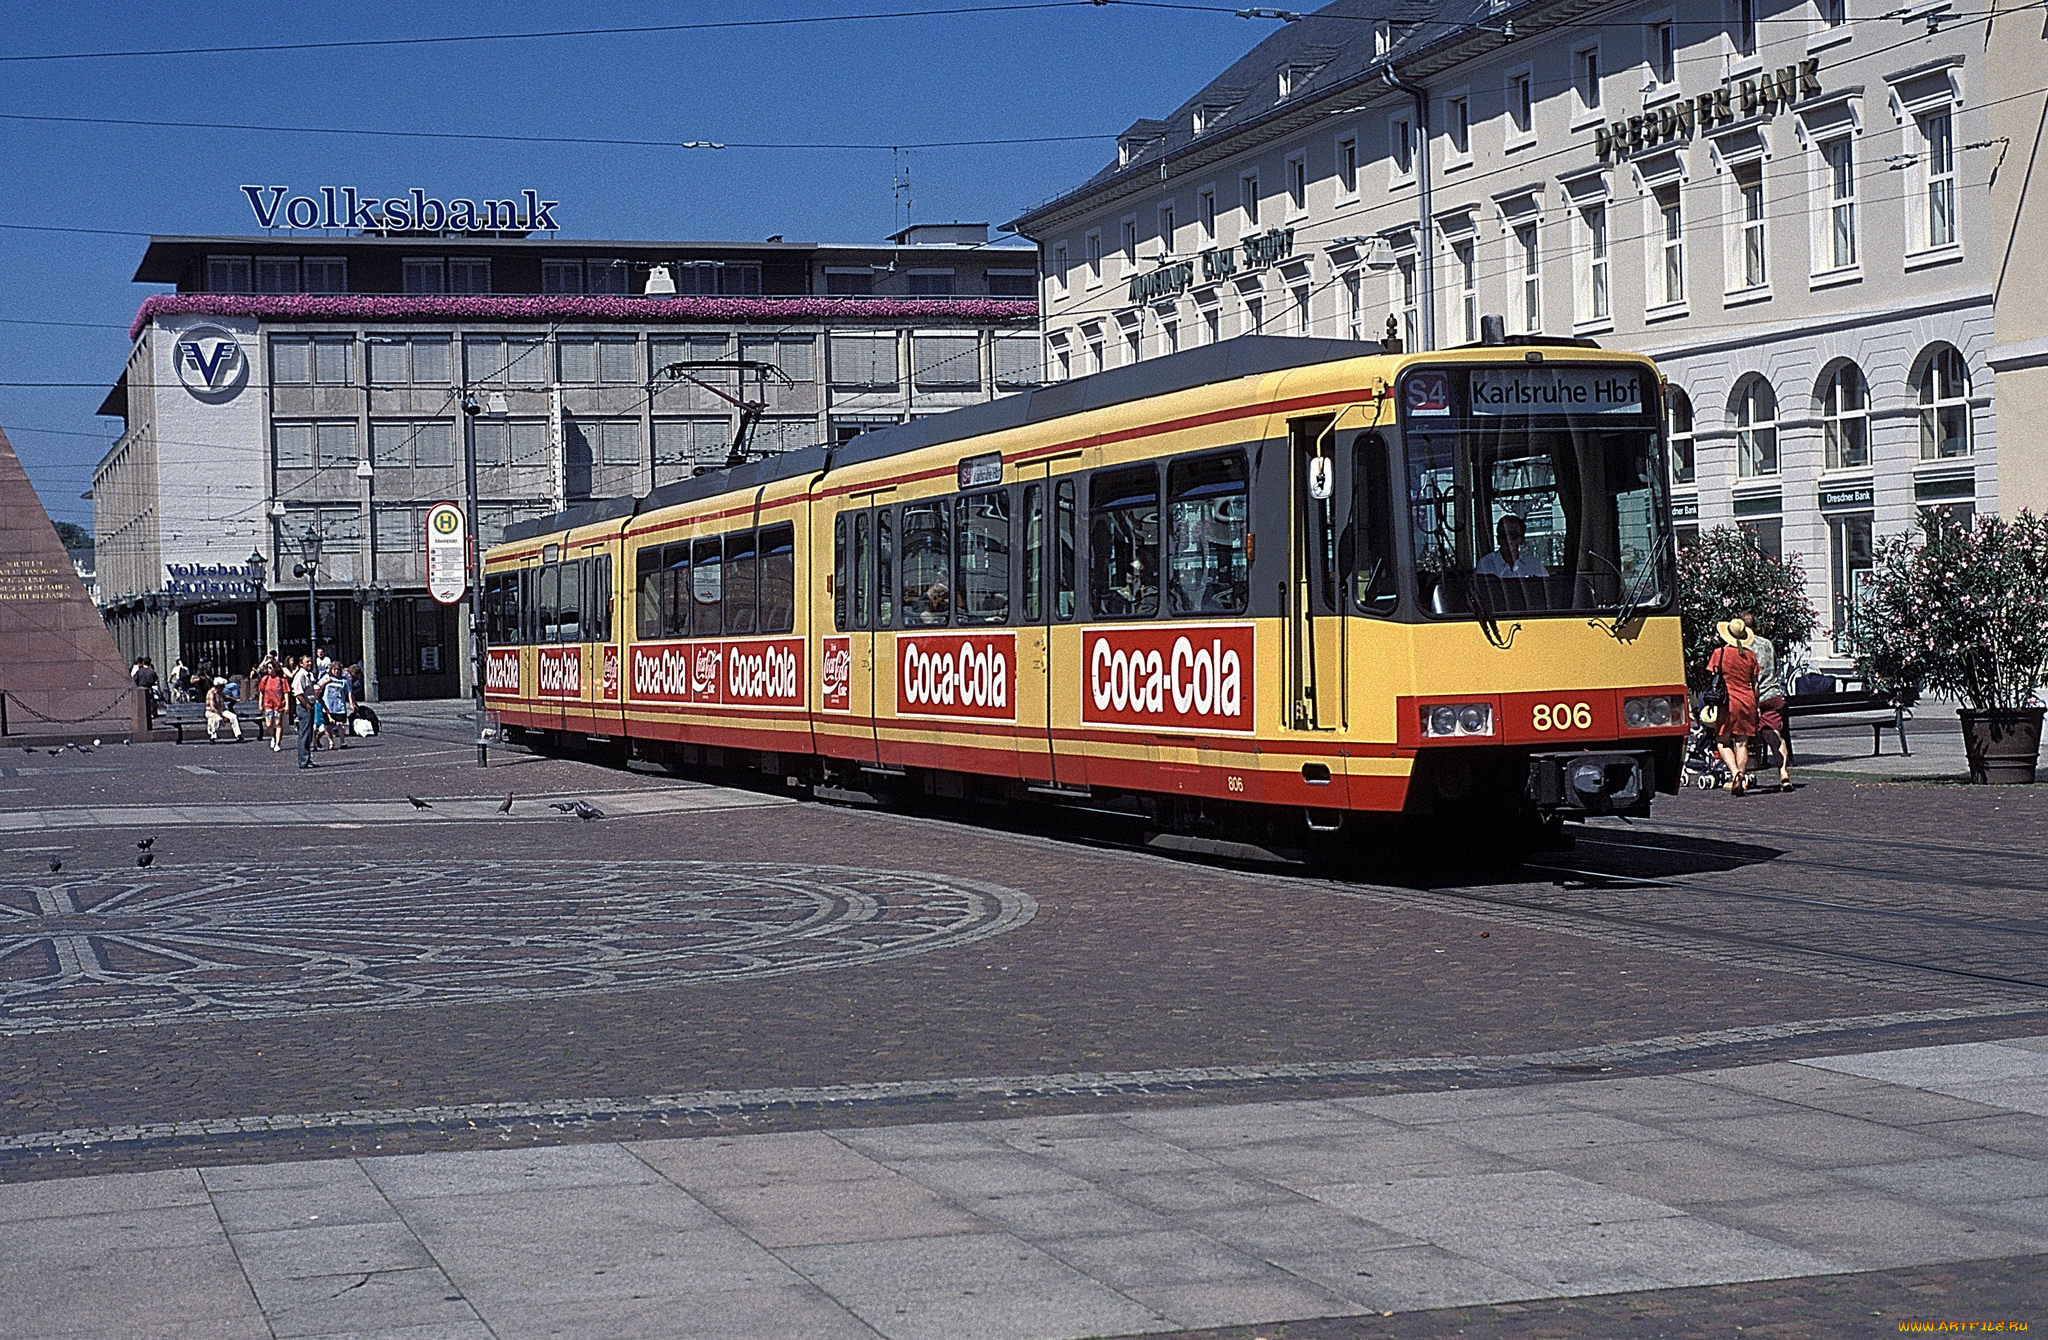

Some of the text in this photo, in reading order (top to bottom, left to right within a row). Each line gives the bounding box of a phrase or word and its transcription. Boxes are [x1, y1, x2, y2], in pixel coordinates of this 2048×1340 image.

[1595, 58, 1823, 158] DRESDNER BANK
[240, 184, 560, 231] Volksbank
[1408, 377, 1639, 406] S4 Karlsruhe Hbf
[1672, 505, 1697, 515] dner Bank
[1826, 490, 1870, 503] Dresdner Bank
[166, 563, 252, 577] Volksban
[486, 653, 518, 688] Coca-Cola
[541, 651, 578, 690] Coca-Cola
[635, 649, 686, 694] Coca-Cola
[729, 645, 796, 698] Coca-Cola
[904, 641, 1007, 708] Coca-Cola
[1091, 636, 1241, 717] Coca-Cola
[1532, 702, 1592, 731] 806
[1228, 776, 1244, 792] 806
